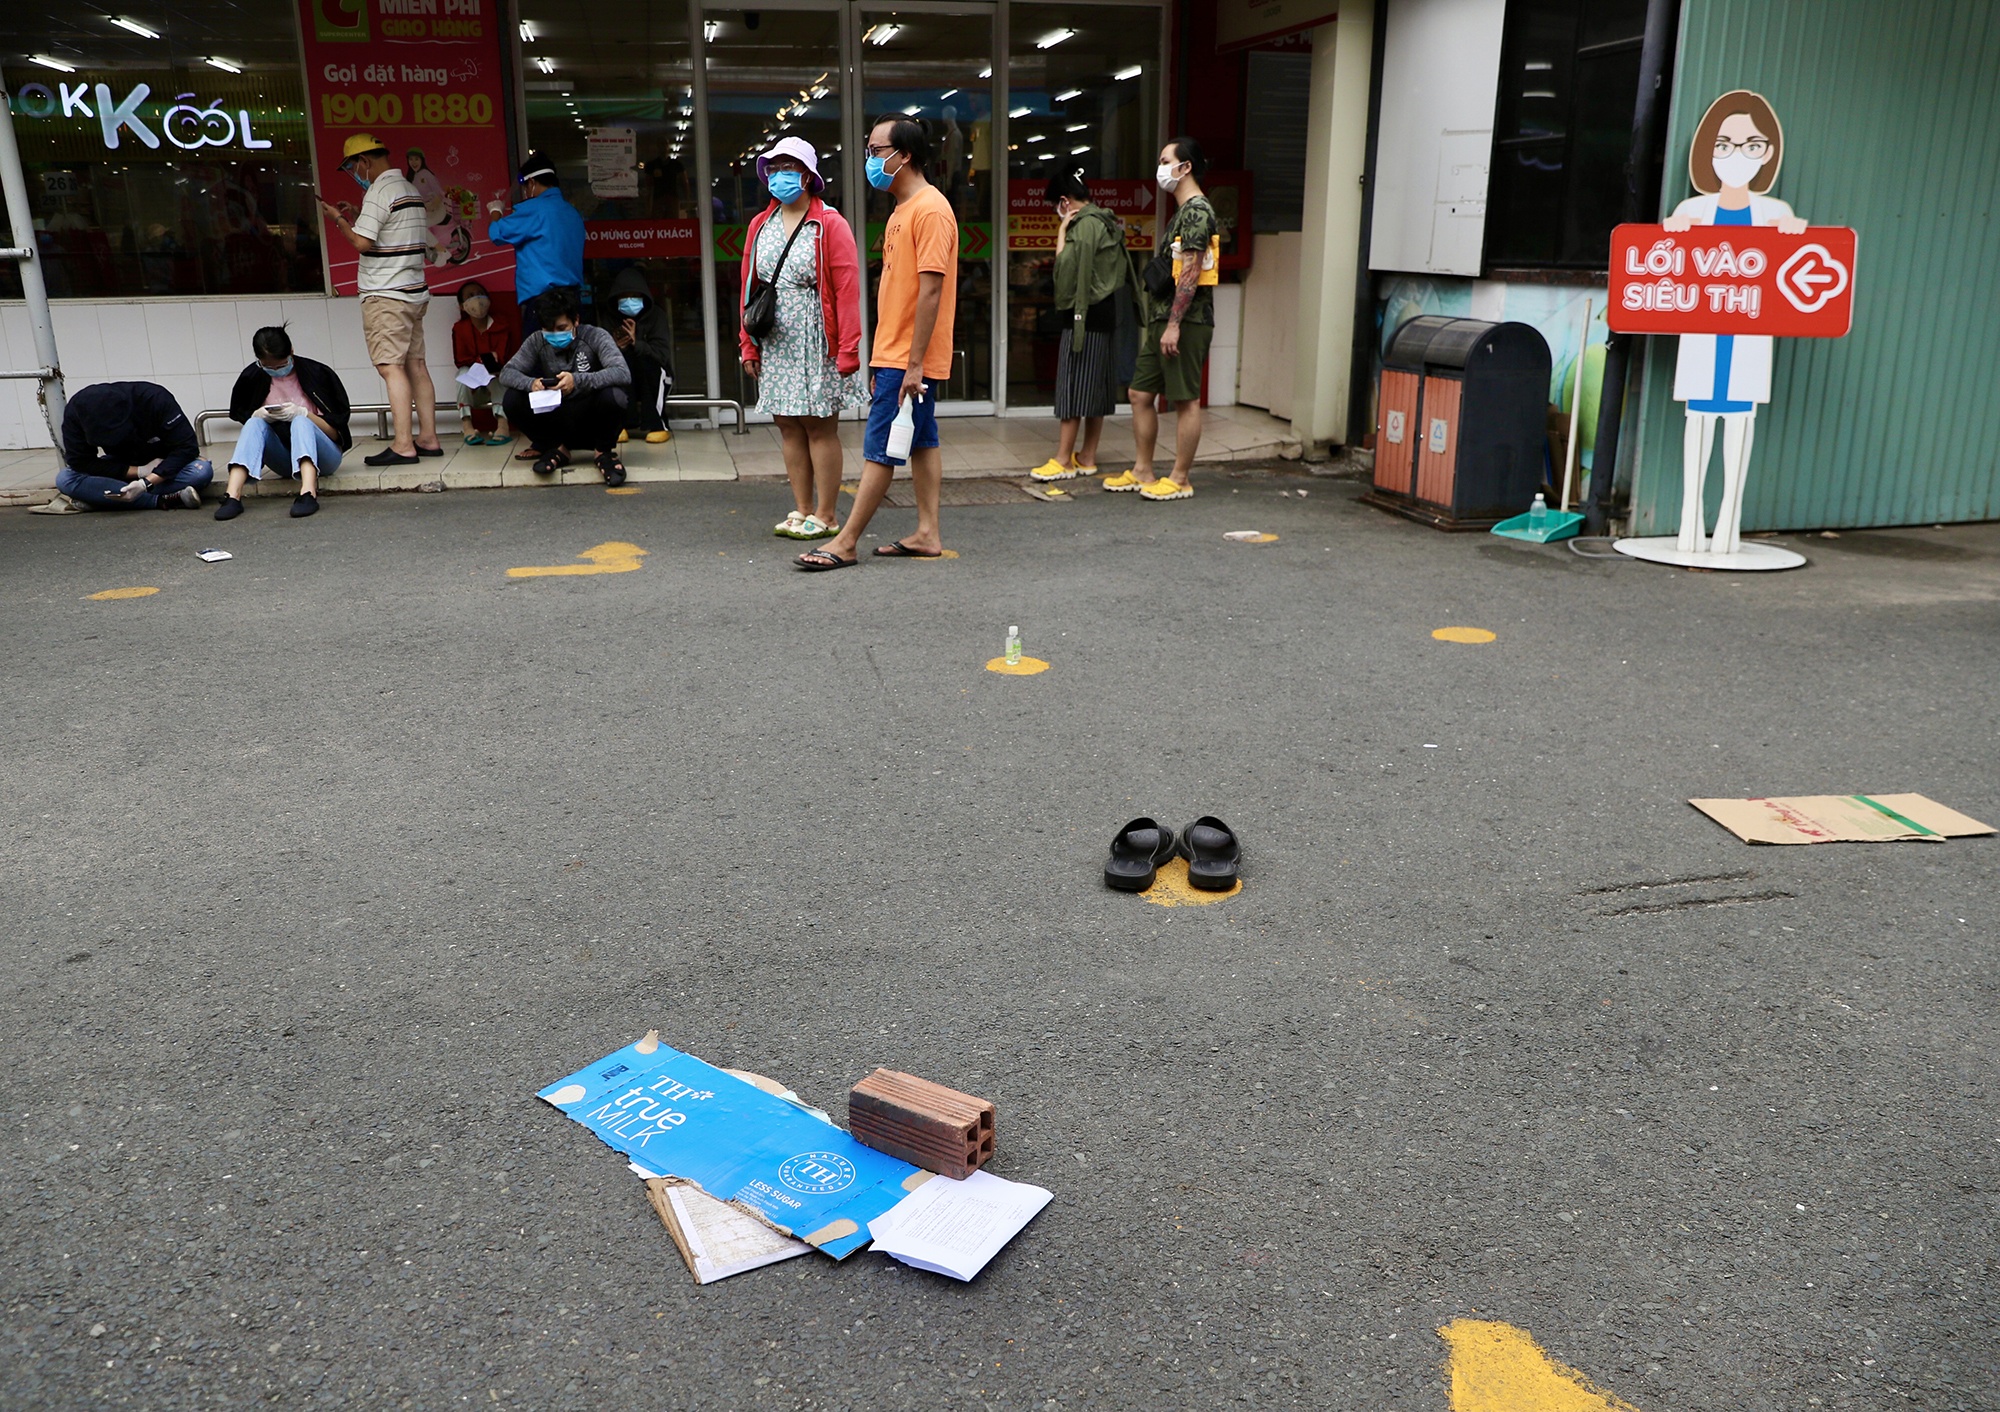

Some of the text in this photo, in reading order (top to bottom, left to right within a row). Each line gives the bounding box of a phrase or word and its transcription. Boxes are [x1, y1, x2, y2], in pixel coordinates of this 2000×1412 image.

[381, 17, 483, 37] GIAO HÀNG
[323, 63, 448, 87] Gọi đặt hàng
[321, 93, 494, 125] 1900 1880
[47, 177, 66, 190] 26
[600, 228, 631, 241] MỪNG
[656, 226, 693, 239] KHÁCH
[1626, 238, 1767, 278] LỐI VÀO
[1622, 277, 1762, 319] SIÊU THỊ
[647, 1075, 695, 1102] TH
[614, 1086, 687, 1131] true
[586, 1102, 666, 1148] MILK
[783, 1165, 834, 1192] GUARANTEED
[799, 1160, 839, 1184] TH
[809, 1153, 851, 1179] NATURE
[749, 1179, 773, 1194] LESS
[770, 1190, 802, 1210] SUGAR
